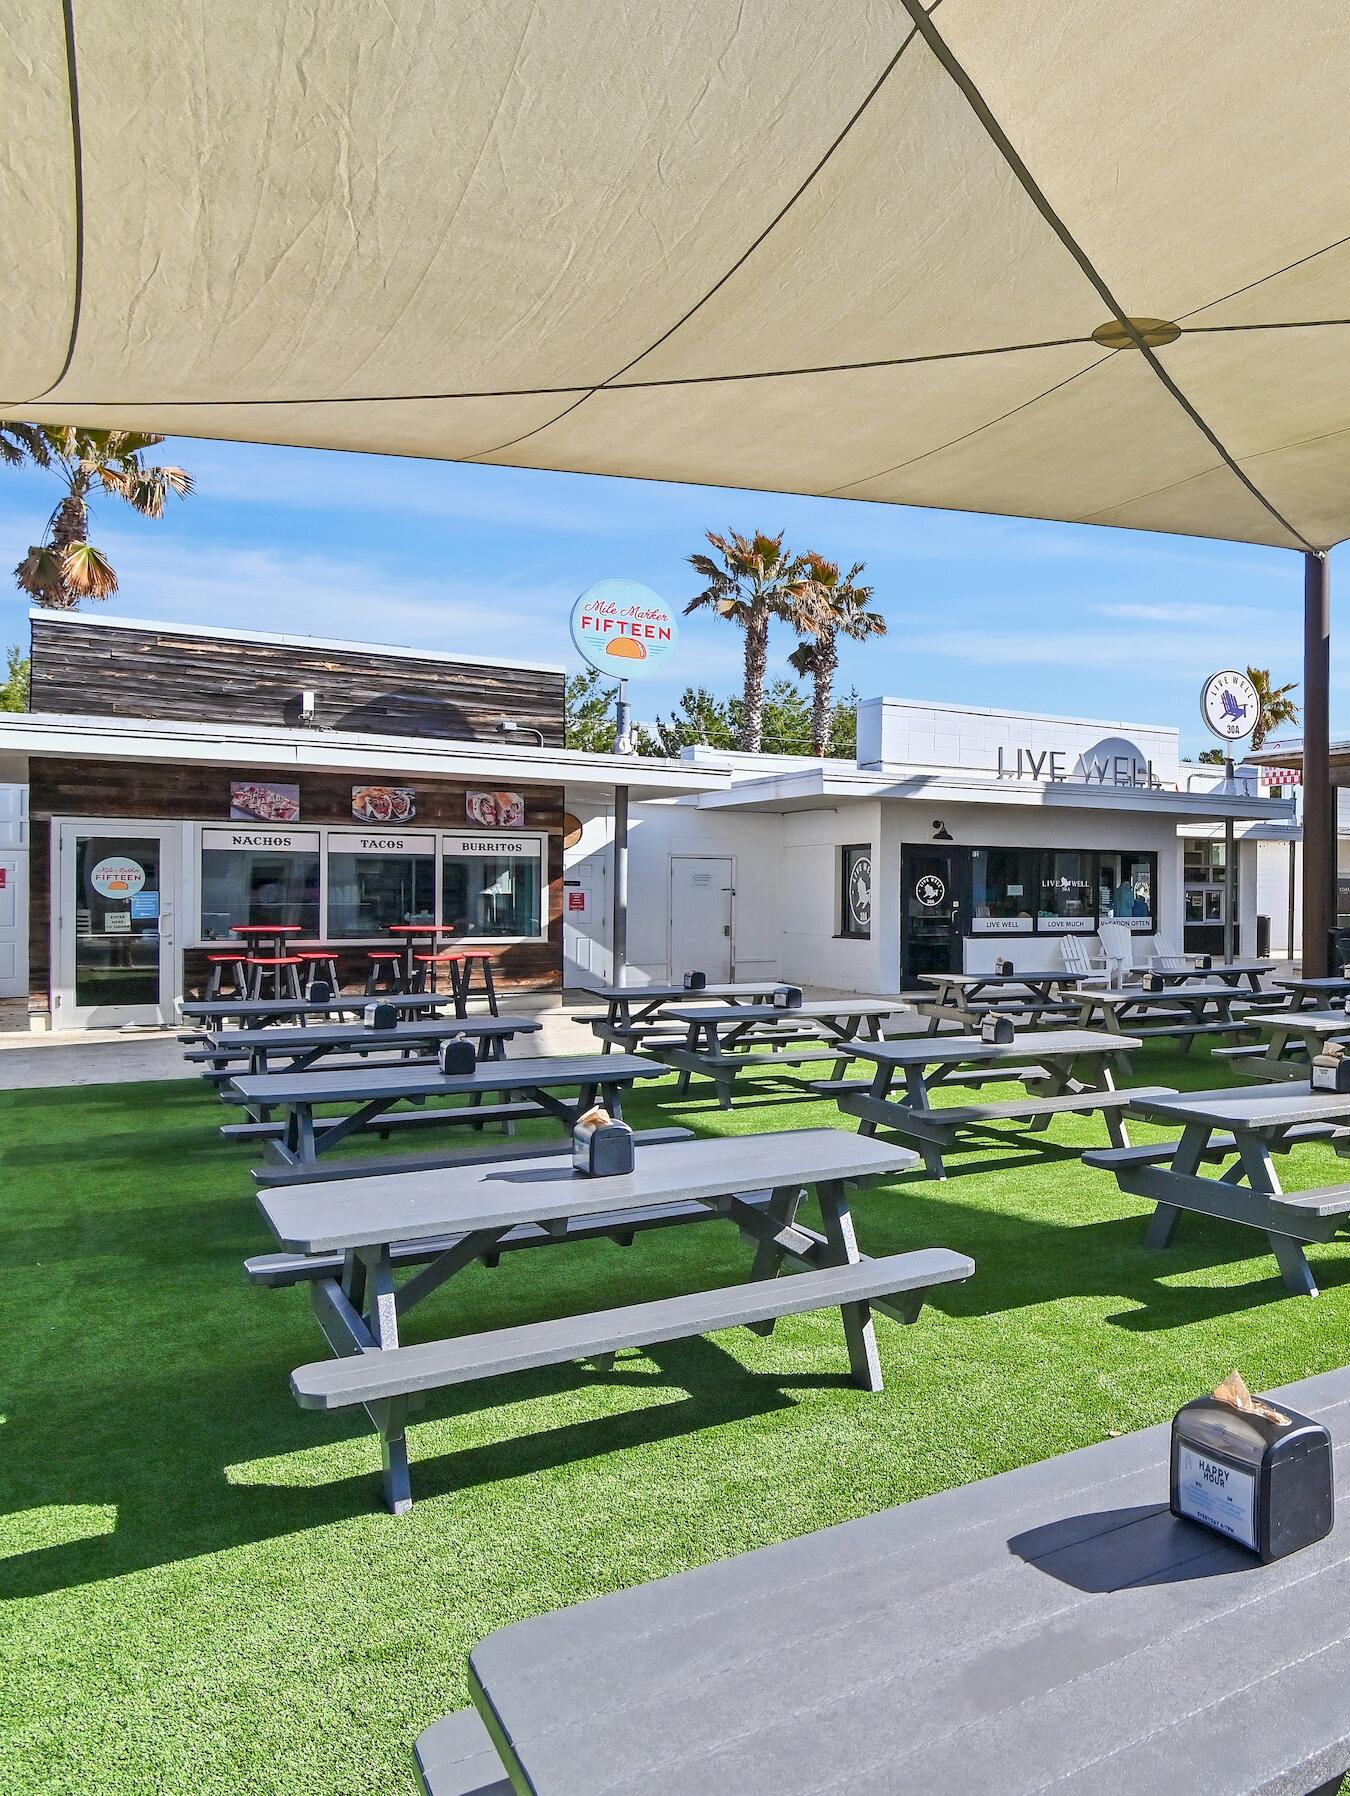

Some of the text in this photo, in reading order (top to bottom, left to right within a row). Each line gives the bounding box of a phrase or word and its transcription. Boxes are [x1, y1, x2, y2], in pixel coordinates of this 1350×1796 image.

[584, 600, 669, 622] Mile Marker
[581, 616, 671, 640] FIFTEEN
[1210, 676, 1253, 699] LIVE WELL
[1226, 724, 1240, 735] 30A
[996, 746, 1162, 789] LIVE WELL
[232, 836, 292, 847] NACHOS
[360, 839, 404, 849] TACOS
[462, 842, 523, 852] BURRITOS
[919, 877, 942, 888] LIVE WELL
[1042, 880, 1089, 888] LIVE WELL
[1199, 1459, 1230, 1482] HAPPY
[1203, 1471, 1225, 1488] HOUR
